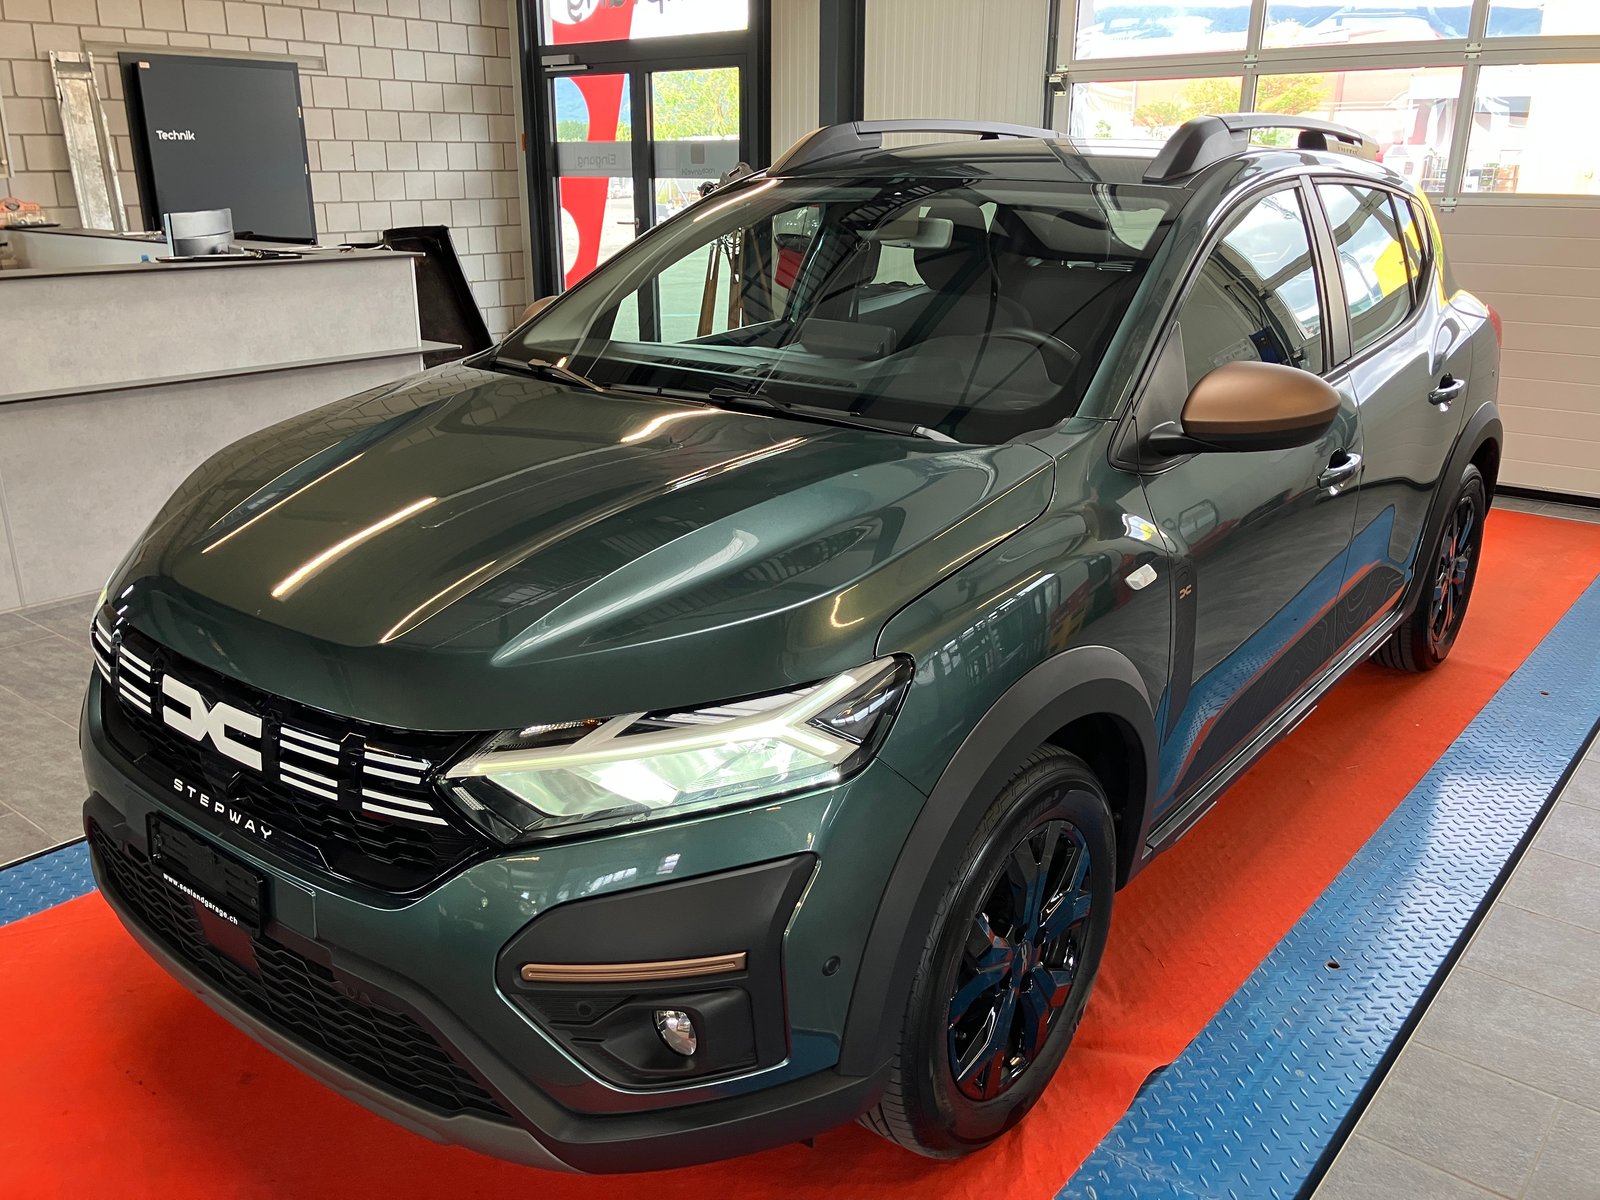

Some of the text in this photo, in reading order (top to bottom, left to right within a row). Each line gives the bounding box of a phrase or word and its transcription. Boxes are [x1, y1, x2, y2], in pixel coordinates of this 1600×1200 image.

[155, 129, 196, 141] Technik
[173, 778, 272, 839] STEPWAY
[162, 872, 239, 926] www.seelandgarage.ch
